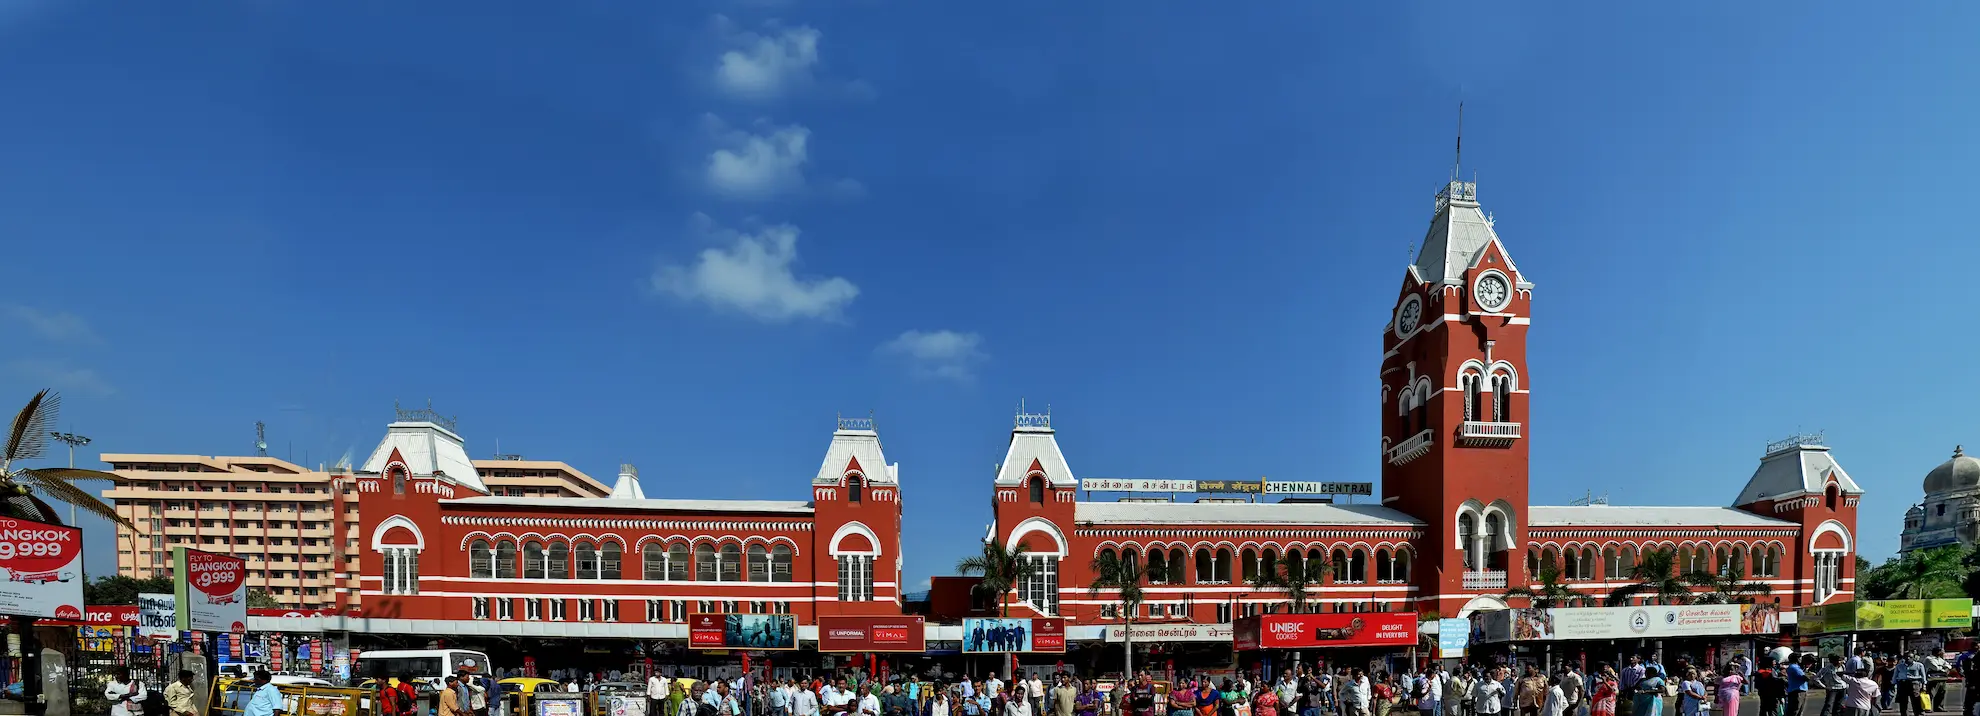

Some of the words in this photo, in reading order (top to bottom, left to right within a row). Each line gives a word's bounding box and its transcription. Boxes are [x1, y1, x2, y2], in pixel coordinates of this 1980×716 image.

[1083, 479, 1133, 490] சென்னை
[1265, 482, 1317, 492] CHENNAI
[1320, 483, 1372, 493] CENTRAL
[2, 520, 18, 529] TO
[190, 561, 240, 572] BANGKOK
[86, 611, 113, 622] nce
[1157, 627, 1197, 638] சென்ட்ரல்
[1269, 622, 1304, 633] UNIBIC
